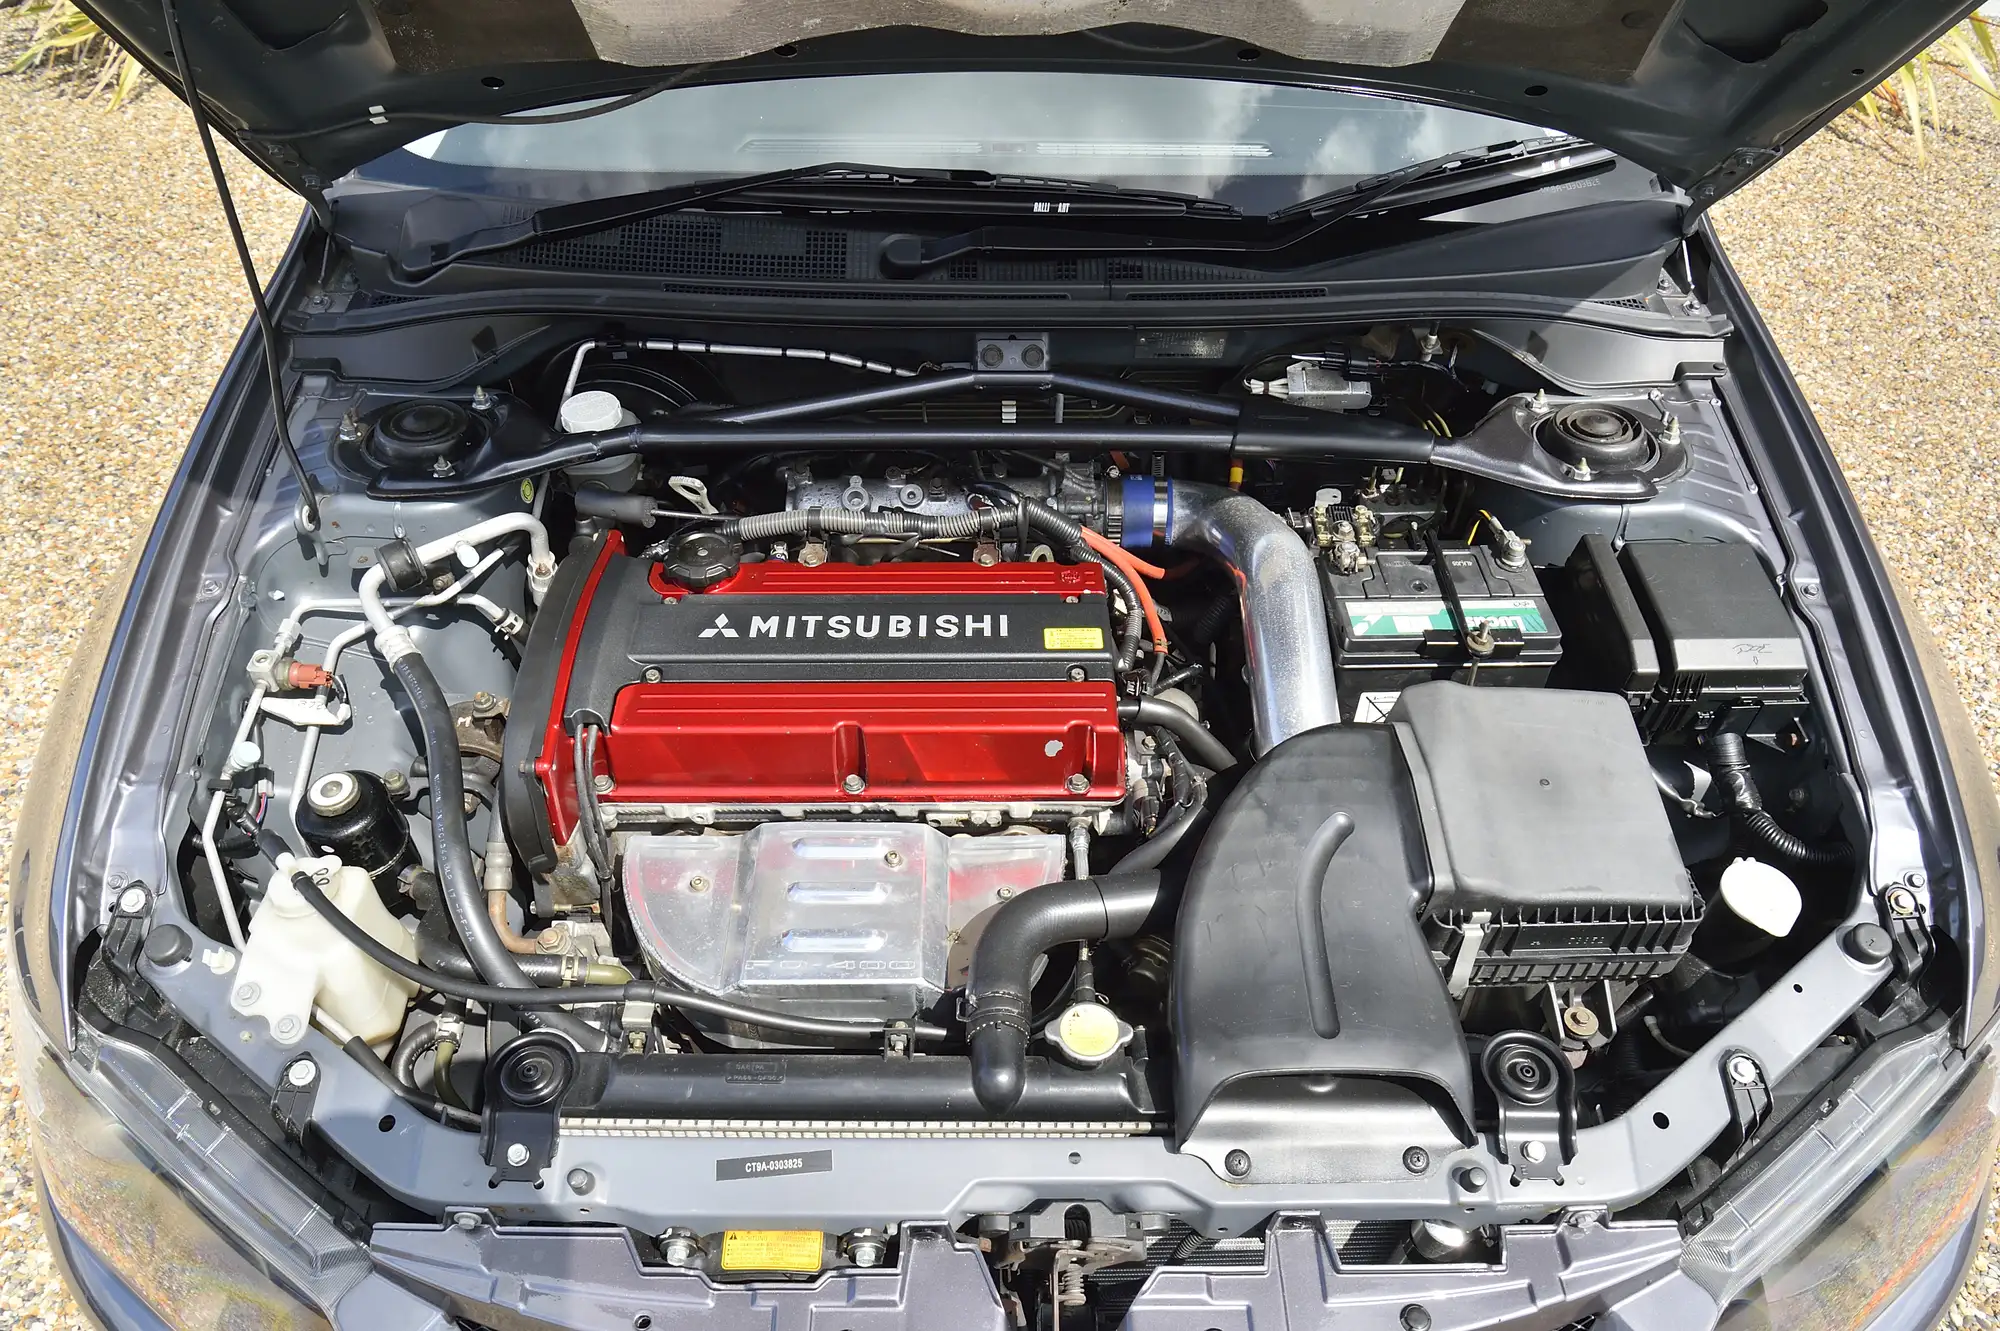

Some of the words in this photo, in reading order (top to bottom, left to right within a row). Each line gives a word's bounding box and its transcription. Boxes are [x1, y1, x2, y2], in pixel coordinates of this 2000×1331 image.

[1057, 202, 1070, 213] ART
[749, 614, 1009, 638] MITSUBISHI
[745, 1158, 803, 1173] CT9A-0303825
